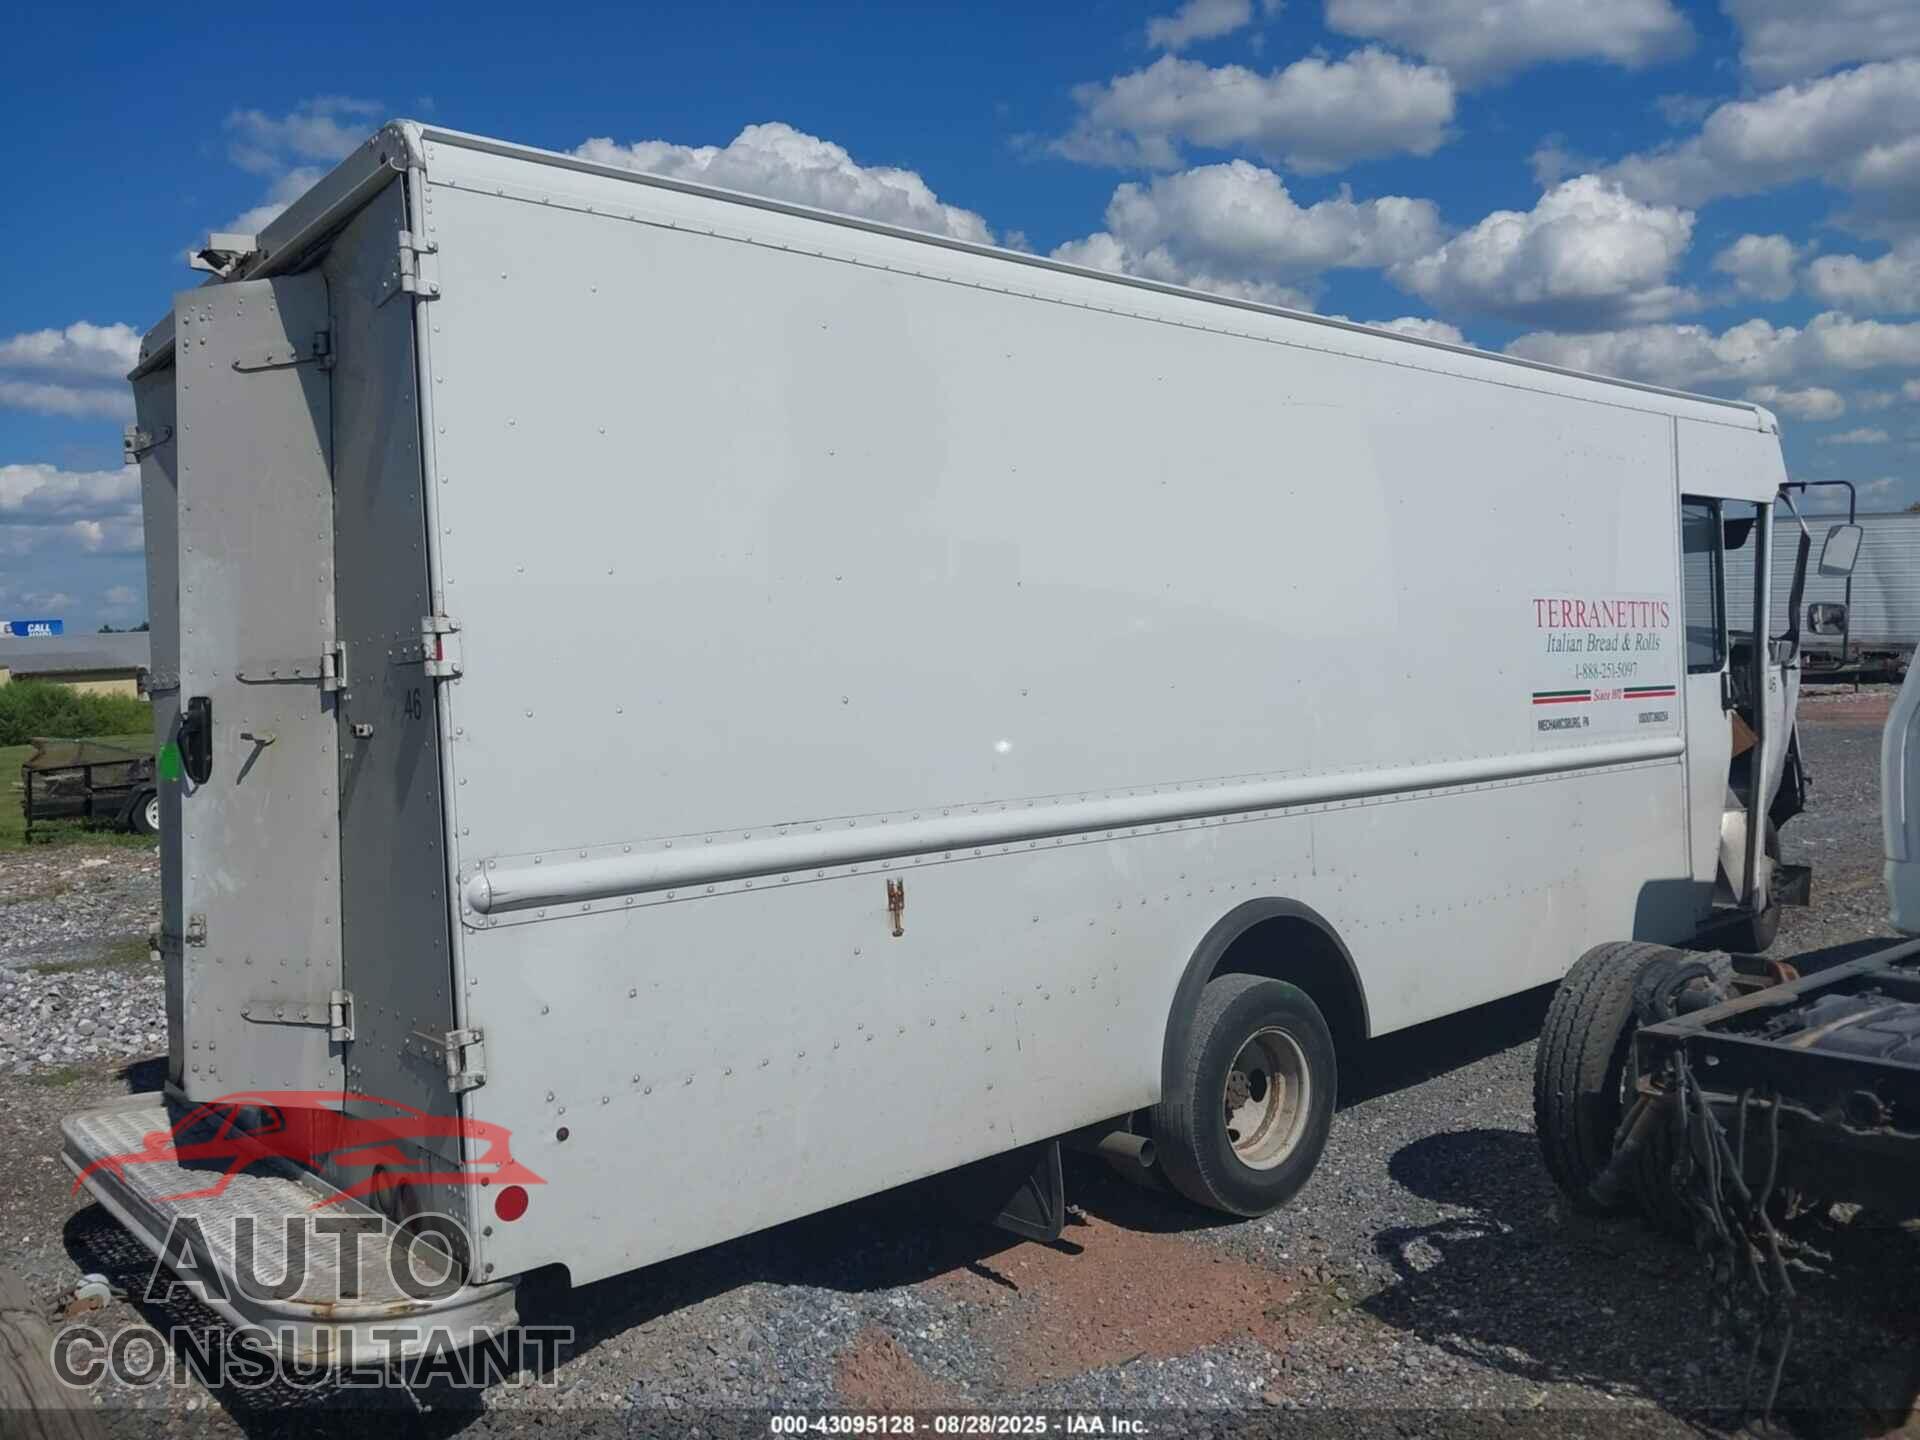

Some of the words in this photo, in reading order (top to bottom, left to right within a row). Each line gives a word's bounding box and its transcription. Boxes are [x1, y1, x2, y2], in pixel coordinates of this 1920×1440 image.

[1533, 599, 1670, 628] TERRANETTI'S
[27, 623, 50, 632] CALL
[1547, 632, 1582, 653] Italian
[1587, 632, 1618, 652] Bread
[1622, 632, 1630, 651] &
[1635, 632, 1660, 651] Rolls
[405, 688, 422, 720] 46
